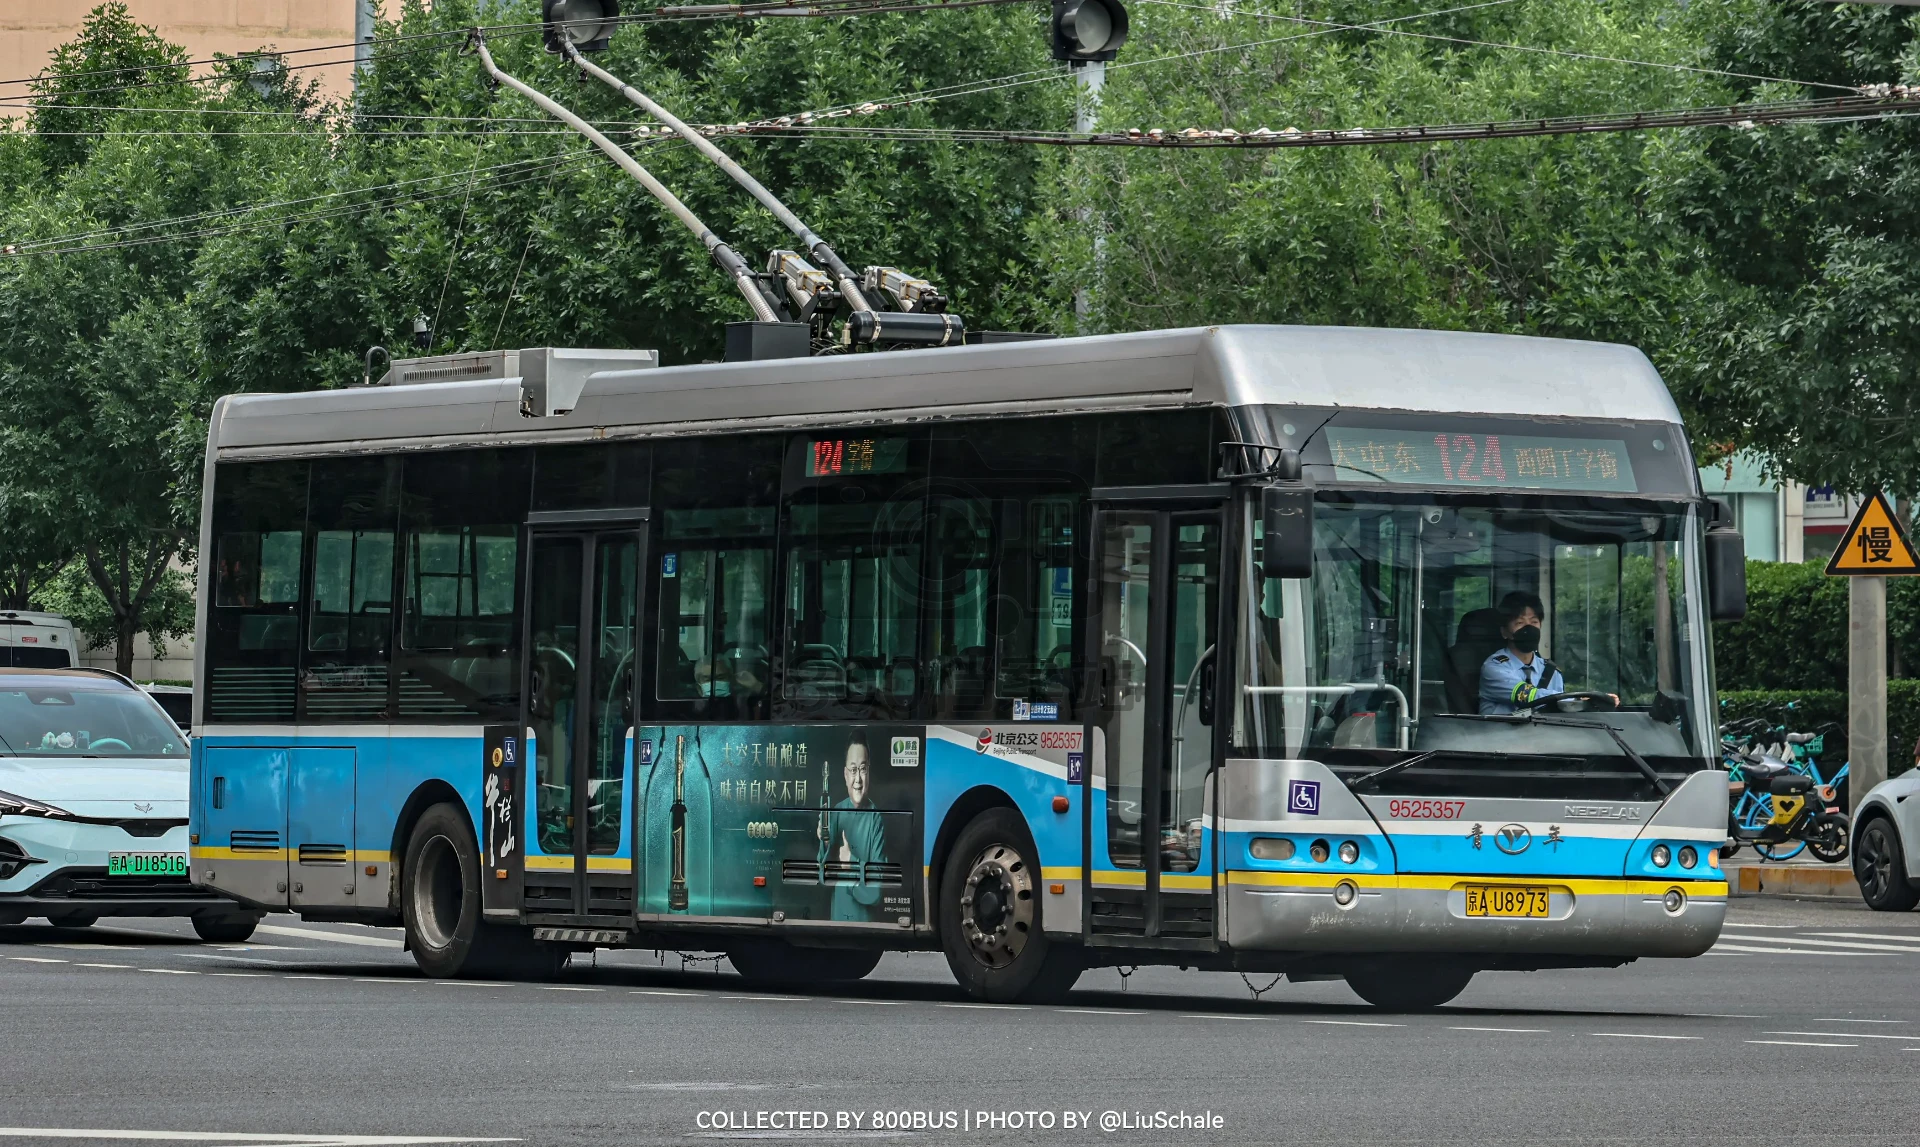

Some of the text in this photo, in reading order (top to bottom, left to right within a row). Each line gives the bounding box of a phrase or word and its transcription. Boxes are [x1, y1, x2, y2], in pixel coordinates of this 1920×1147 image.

[813, 440, 844, 474] 124
[1330, 433, 1618, 482] 大屯东 124 西四丁字街
[1857, 527, 1893, 563] 慢
[993, 747, 1006, 757] Beijing
[994, 731, 1083, 749] 北京公交 9525357
[720, 778, 808, 807] 味道自然不同
[485, 773, 515, 868] 牛栏山
[1389, 799, 1466, 820] 9525357
[1564, 805, 1640, 820] NEOPLAN
[1465, 823, 1565, 853] 青 年
